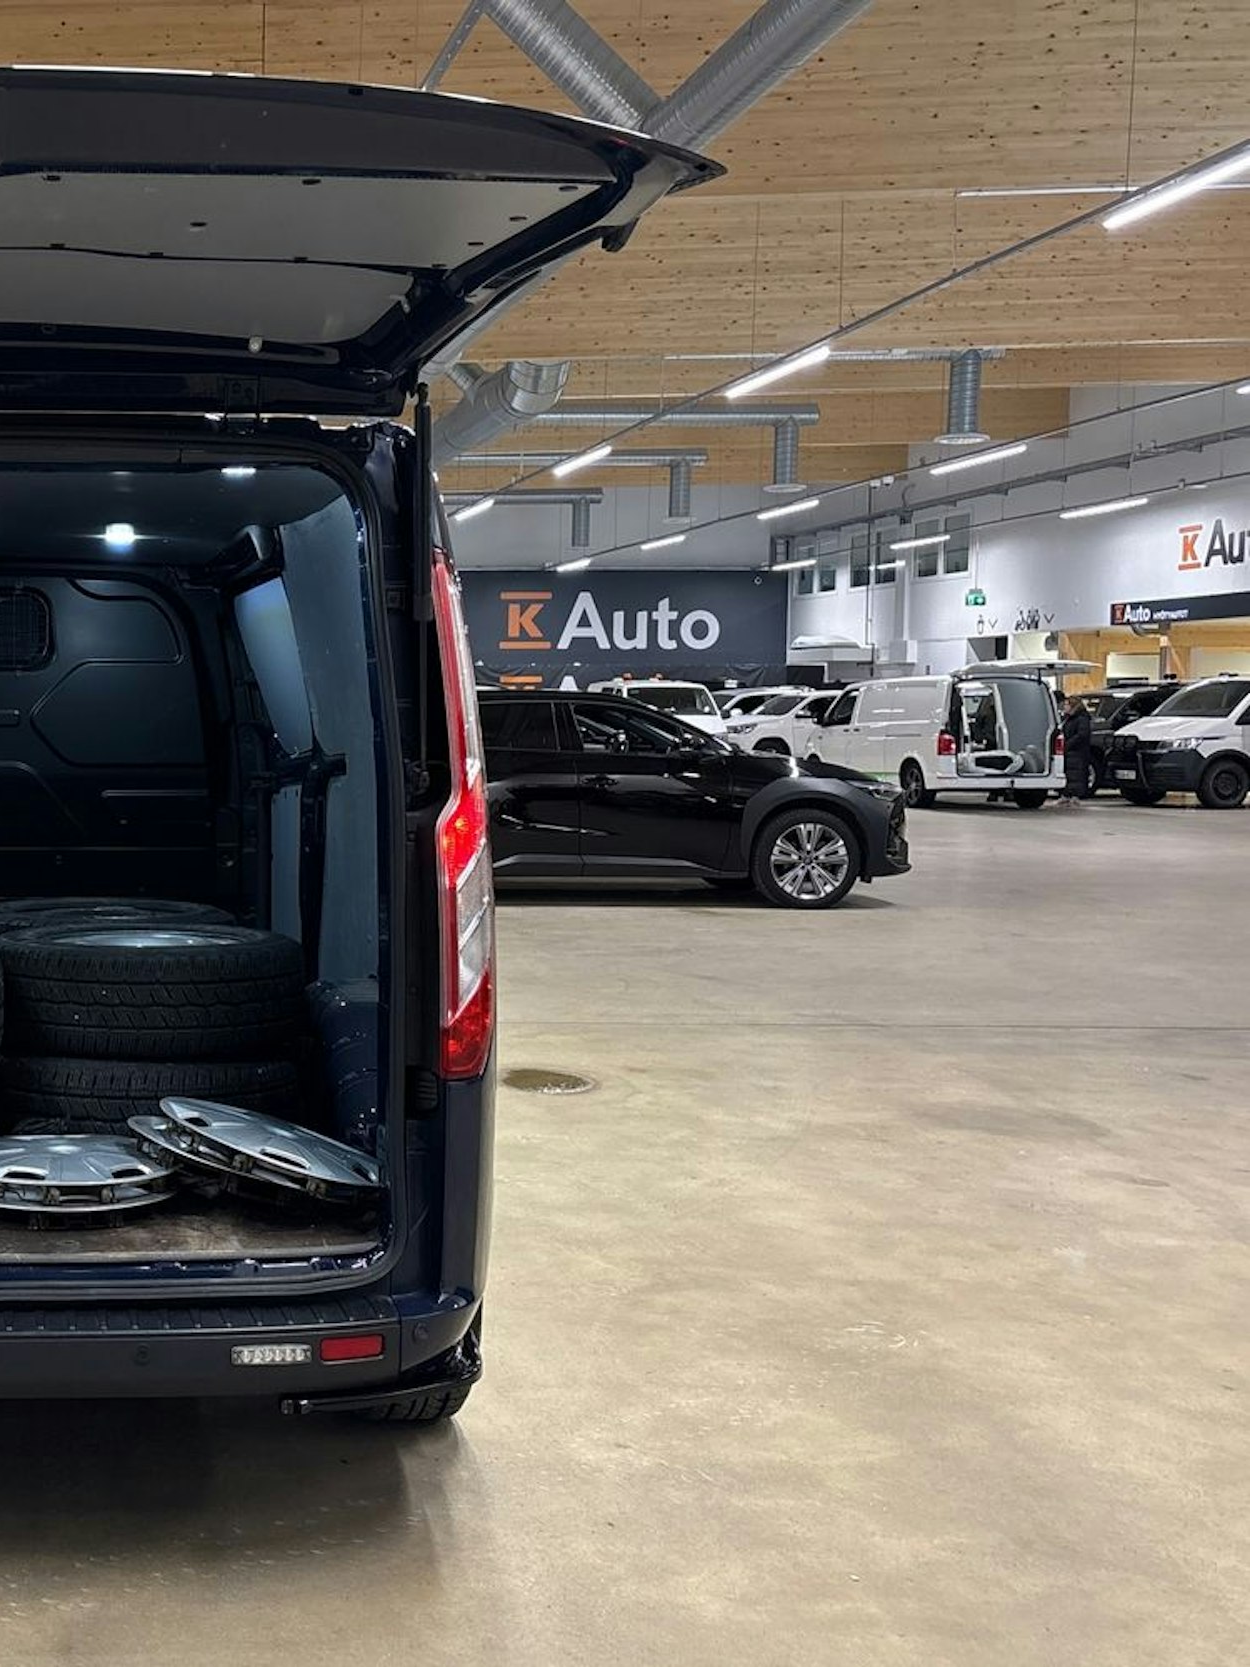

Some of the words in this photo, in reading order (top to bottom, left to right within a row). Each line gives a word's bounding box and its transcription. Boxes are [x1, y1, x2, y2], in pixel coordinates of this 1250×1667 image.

[1204, 518, 1250, 567] Au
[556, 590, 721, 650] Auto
[1123, 604, 1151, 622] Auto
